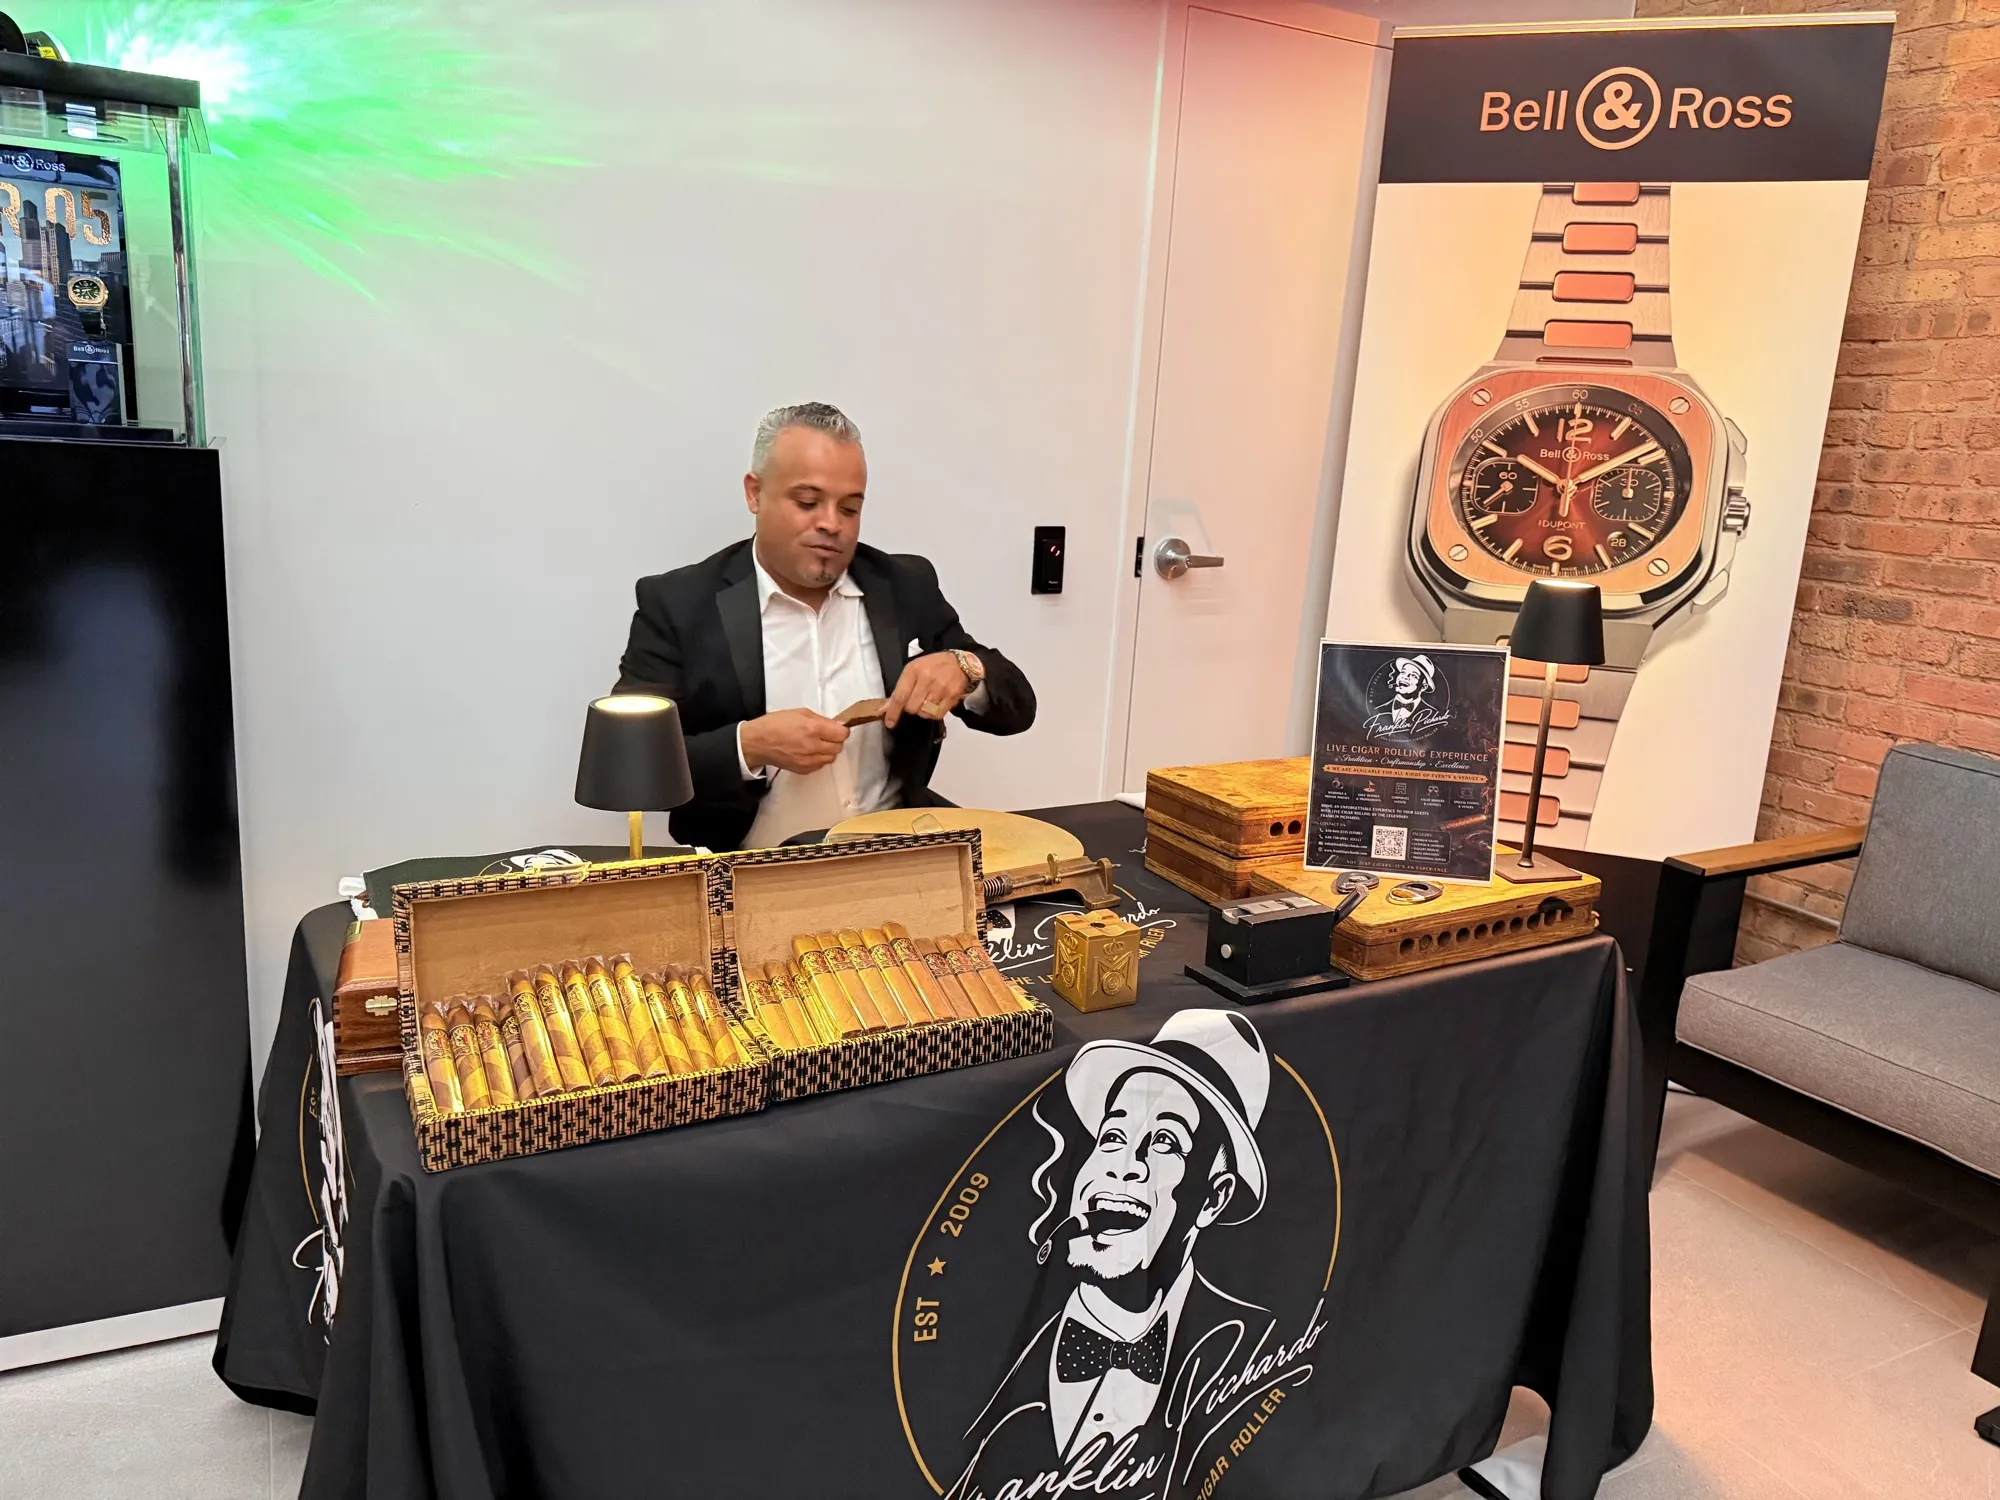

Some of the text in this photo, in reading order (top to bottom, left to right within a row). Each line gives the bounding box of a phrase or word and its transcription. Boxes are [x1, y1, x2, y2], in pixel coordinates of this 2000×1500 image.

[1479, 90, 1568, 132] Bell
[1668, 87, 1793, 129] Ross
[35, 159, 66, 172] Ross
[0, 181, 21, 239] R
[1571, 389, 1589, 400] 60
[1515, 398, 1530, 411] 55
[1627, 402, 1644, 416] 05
[1470, 428, 1483, 443] 50
[1556, 418, 1594, 444] 12
[1540, 448, 1561, 459] Bell
[1582, 451, 1610, 461] Ross
[1498, 471, 1518, 480] 60
[1542, 535, 1573, 561] 6
[1610, 538, 1627, 548] 28
[1362, 712, 1412, 740] Franklin
[1326, 744, 1489, 762] LIVE CIGAR ROLLING EXPERIENCE
[1340, 754, 1471, 770] Tradition Craftsmanship Excellence
[913, 1172, 989, 1342] EST 2009
[1163, 1298, 1329, 1500] Pichardo
[1229, 1387, 1287, 1458] ROLLER
